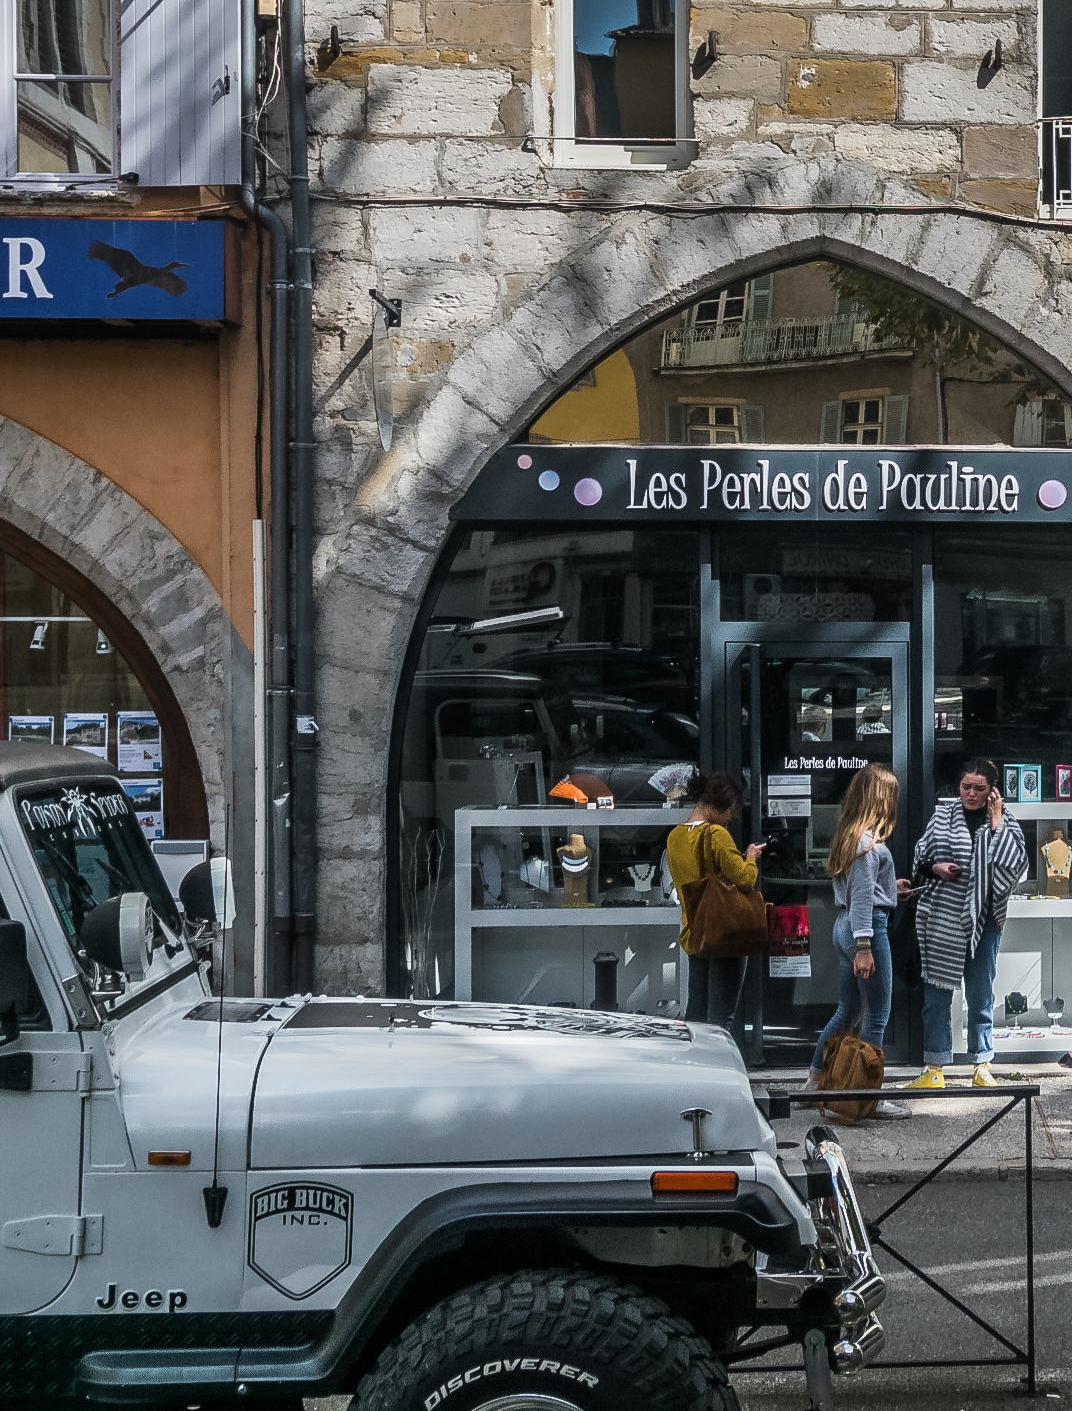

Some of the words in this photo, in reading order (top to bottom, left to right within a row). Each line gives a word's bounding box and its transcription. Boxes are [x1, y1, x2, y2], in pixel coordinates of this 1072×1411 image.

[626, 459, 687, 510] Les
[700, 459, 811, 511] Perles
[823, 459, 868, 512] de
[878, 459, 1020, 512] Pauline
[784, 756, 798, 769] Les
[799, 756, 824, 769] Perles
[825, 756, 836, 769] de
[837, 756, 869, 769] Pauline
[256, 1190, 289, 1217] BIG
[294, 1189, 348, 1218] BUCK
[282, 1214, 328, 1226] INC.
[96, 1282, 188, 1313] Jeep
[424, 1357, 600, 1411] DISCOVERER
